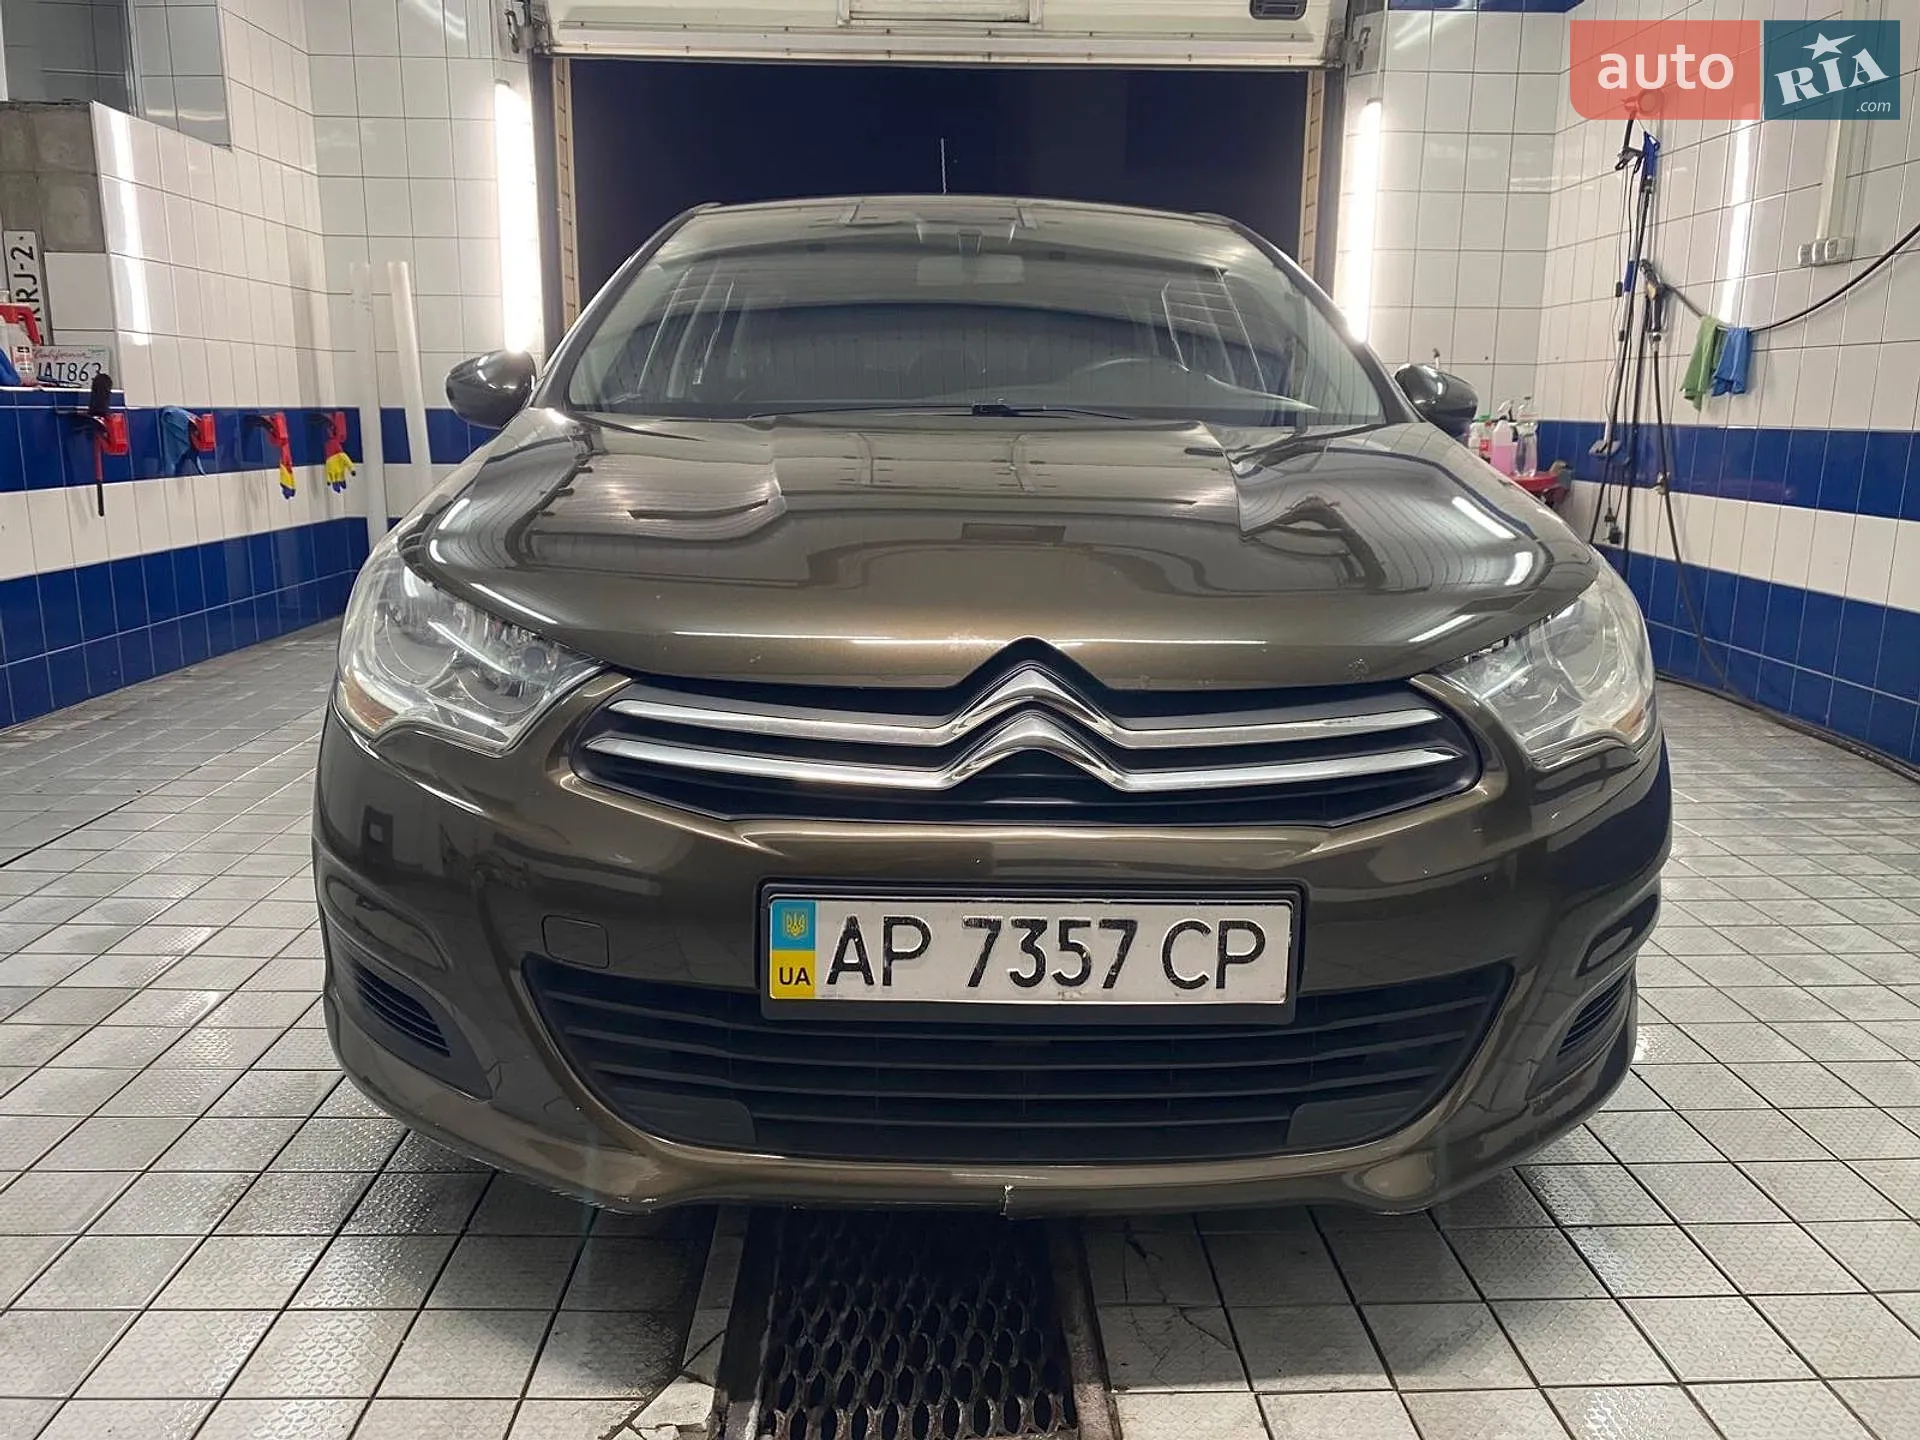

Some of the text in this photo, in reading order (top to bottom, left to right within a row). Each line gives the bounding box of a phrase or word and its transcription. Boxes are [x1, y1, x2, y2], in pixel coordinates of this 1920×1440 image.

[826, 915, 1267, 990] AP 7357 CP
[779, 967, 811, 986] UA
